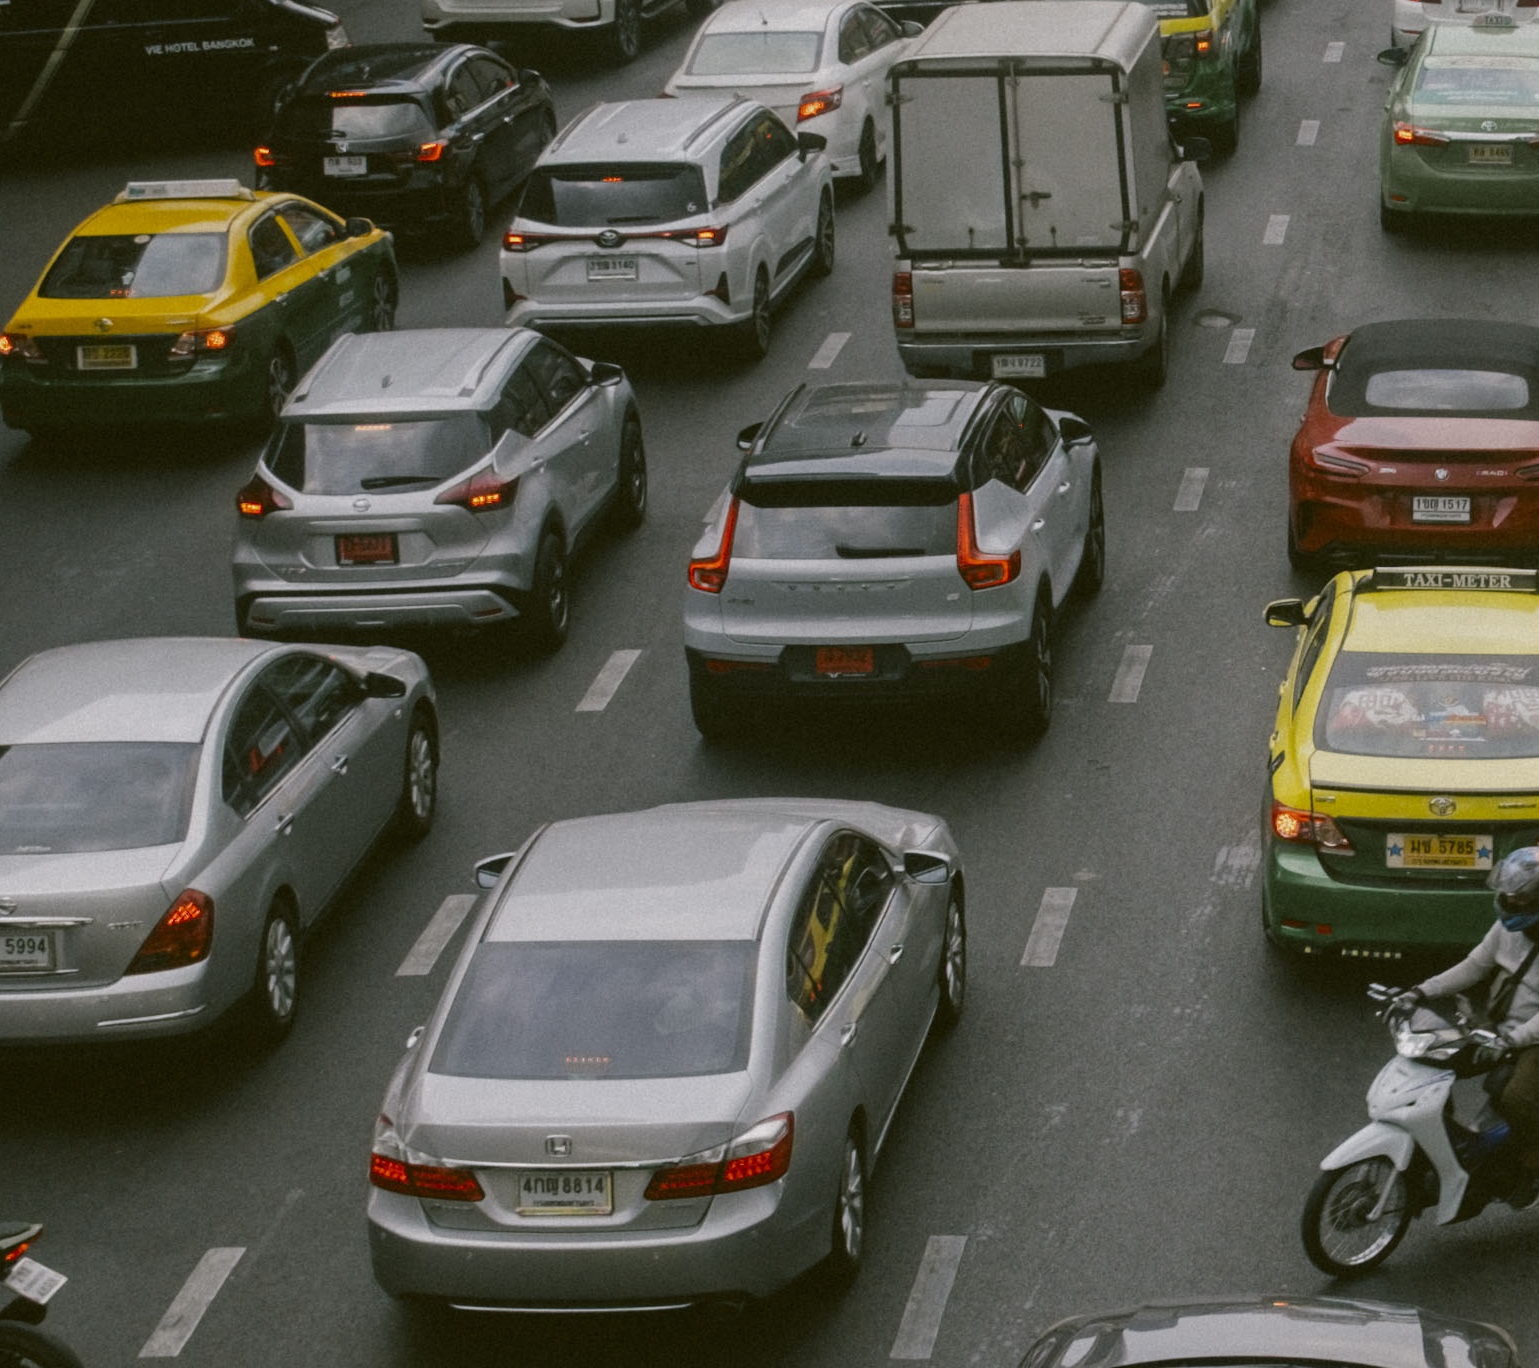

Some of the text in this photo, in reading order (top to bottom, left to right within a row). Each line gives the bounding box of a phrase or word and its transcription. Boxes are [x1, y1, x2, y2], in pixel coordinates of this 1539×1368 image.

[145, 38, 255, 56] VIE HOTEL BANGKOK
[1442, 499, 1468, 510] 1517
[1403, 573, 1512, 589] TAXI-METER
[1439, 839, 1474, 854] 5785
[5, 938, 46, 955] 5994
[562, 1177, 604, 1194] 8814
